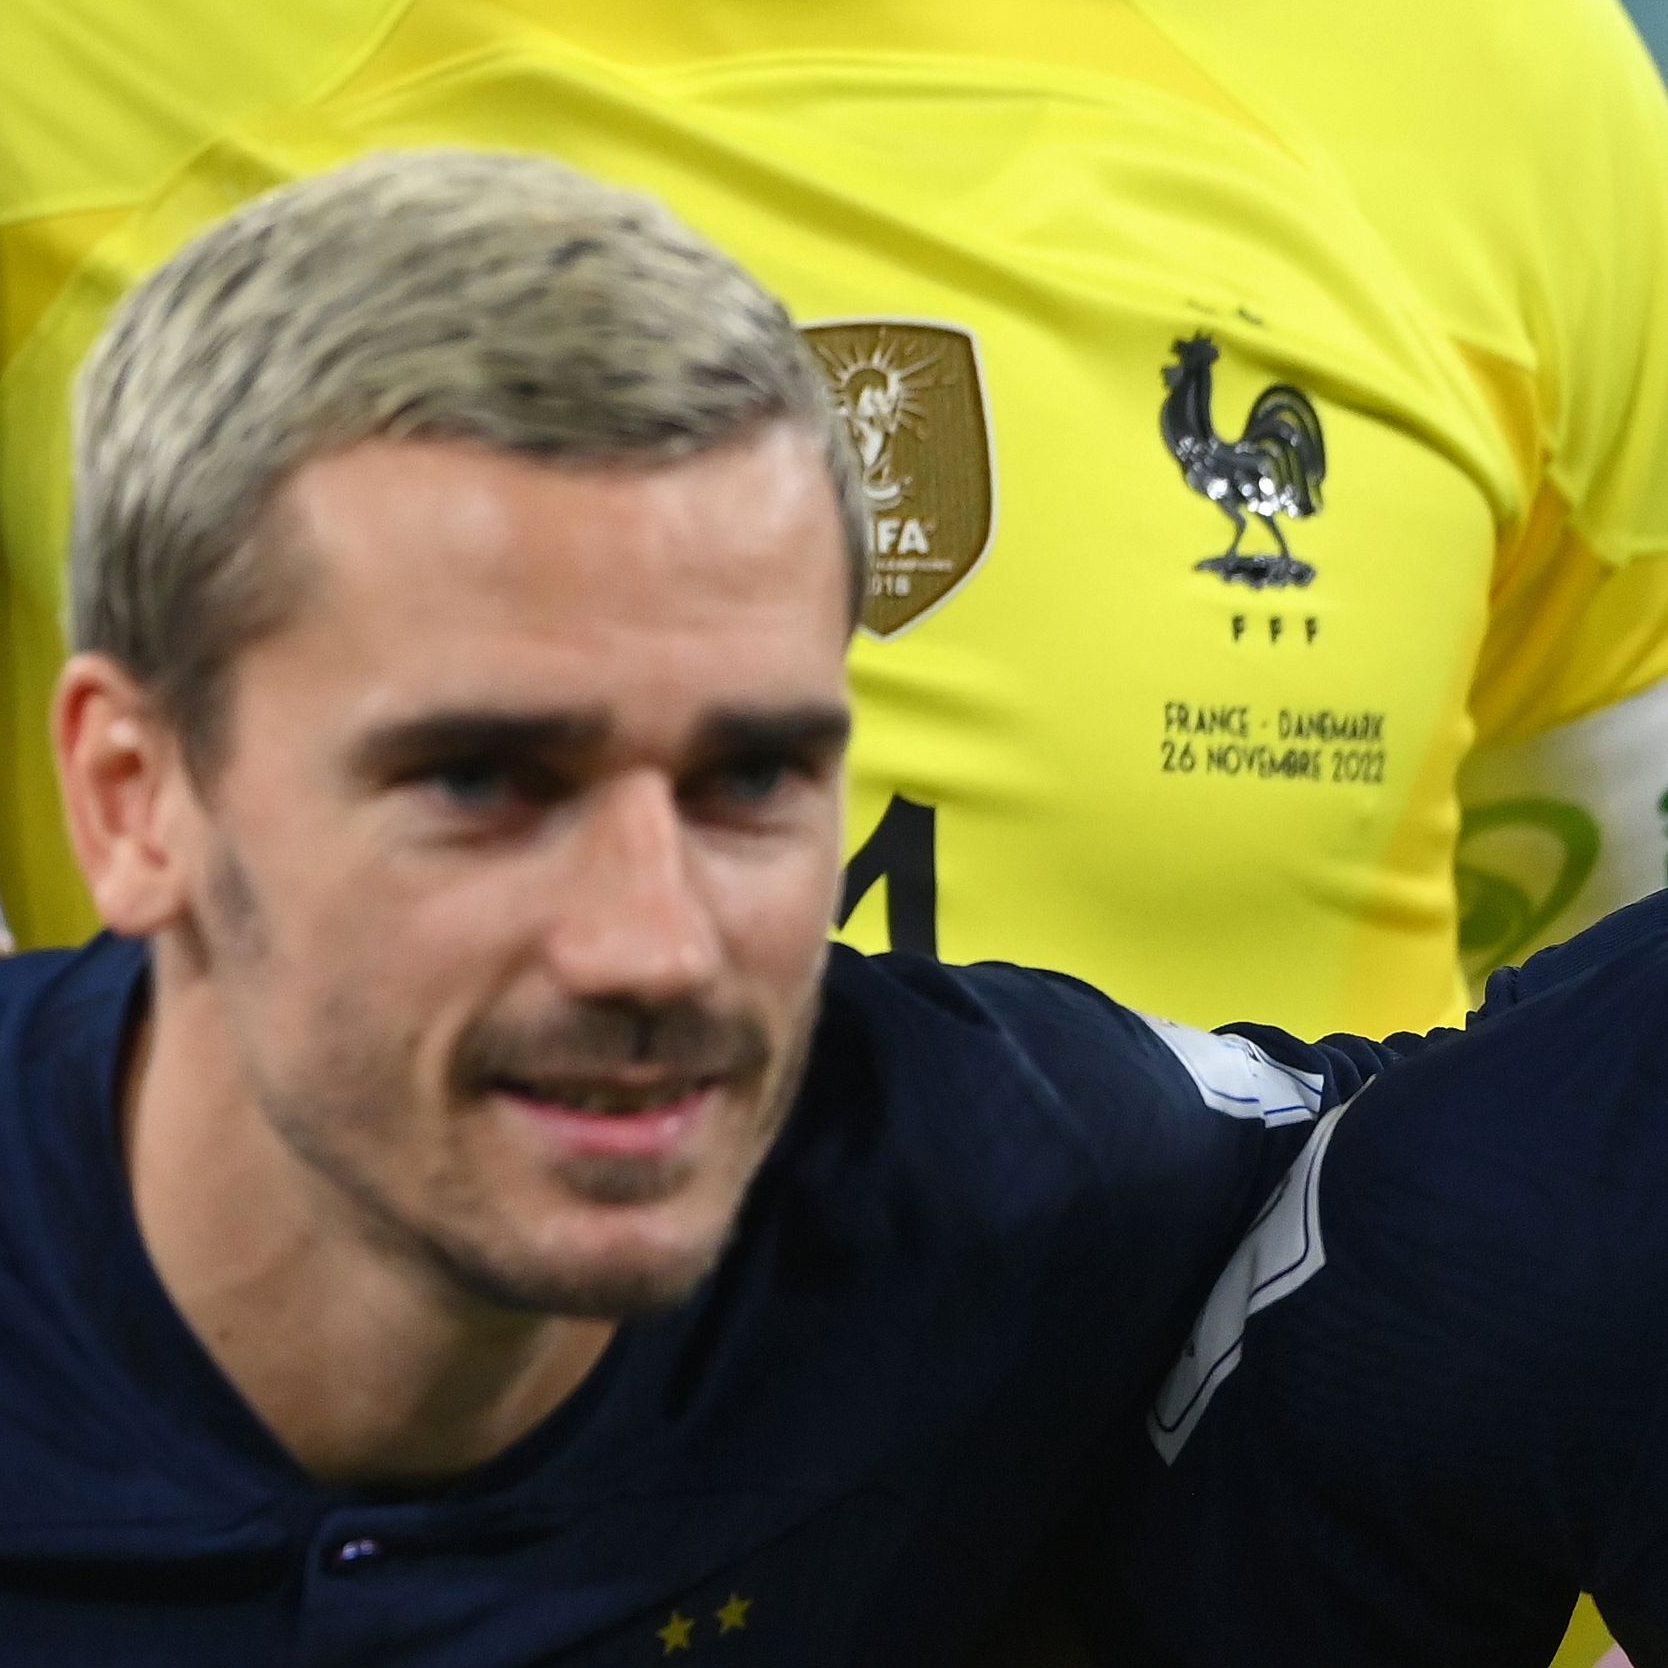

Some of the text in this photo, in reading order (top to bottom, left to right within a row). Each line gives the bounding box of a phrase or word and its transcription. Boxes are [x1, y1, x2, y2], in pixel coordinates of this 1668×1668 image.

[866, 516, 930, 554] IFA
[1164, 702, 1249, 738] FRANCE
[1278, 707, 1385, 743] DANEMARK
[1160, 740, 1386, 784] 26 NOVEMBRE 2022
